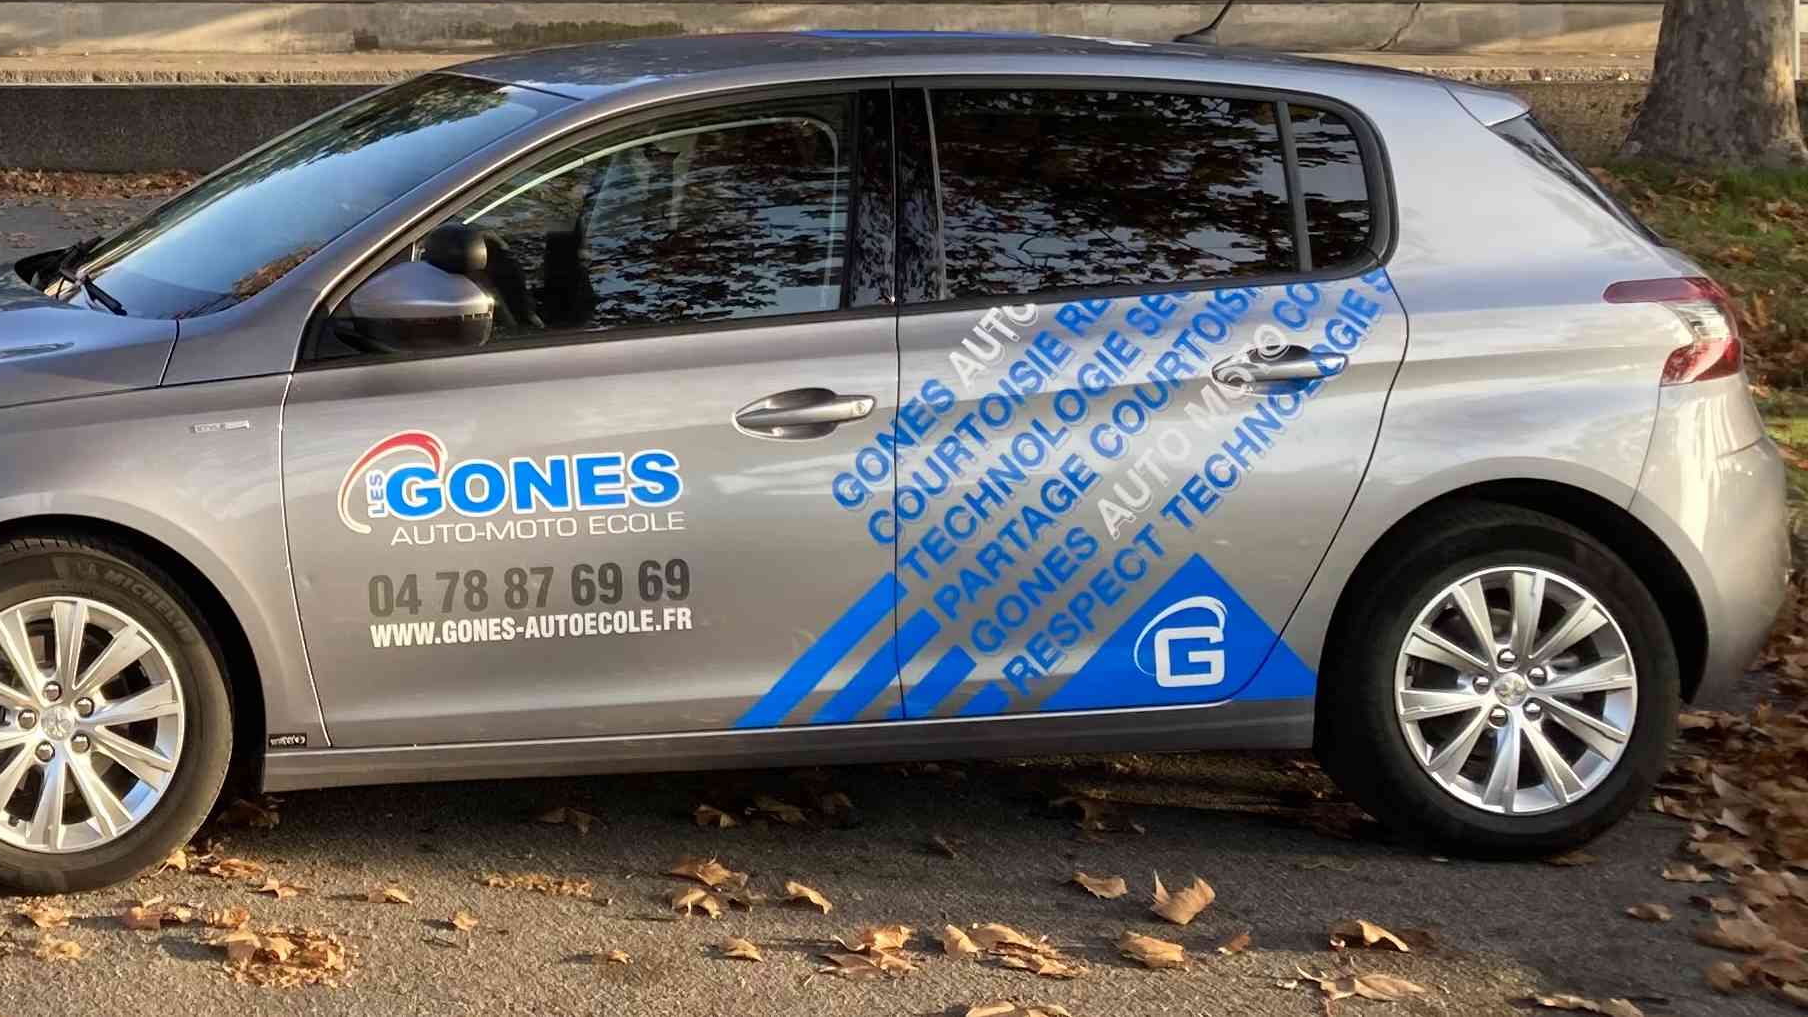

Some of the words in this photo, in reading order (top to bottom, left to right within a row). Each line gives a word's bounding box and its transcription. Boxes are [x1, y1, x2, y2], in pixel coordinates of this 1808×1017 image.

[369, 473, 386, 517] LES
[384, 450, 684, 520] GONES
[832, 379, 956, 509] GONES
[868, 329, 1073, 545] COURTOISIE
[898, 330, 1142, 580] TECHNOLOGIE
[368, 574, 422, 617] 04
[435, 570, 488, 614] 78
[504, 566, 555, 611] 87
[570, 563, 623, 607] 69
[637, 558, 691, 602] 69
[390, 516, 577, 546] AUTO-MOTO
[589, 511, 686, 536] ECOLE
[933, 453, 1098, 620] PARTAGE
[970, 526, 1098, 652] GONES
[1097, 429, 1192, 541] AUTO
[369, 608, 693, 647] WWW.GONES-AUTOECOLE.FR
[1001, 523, 1164, 696] RESPECT
